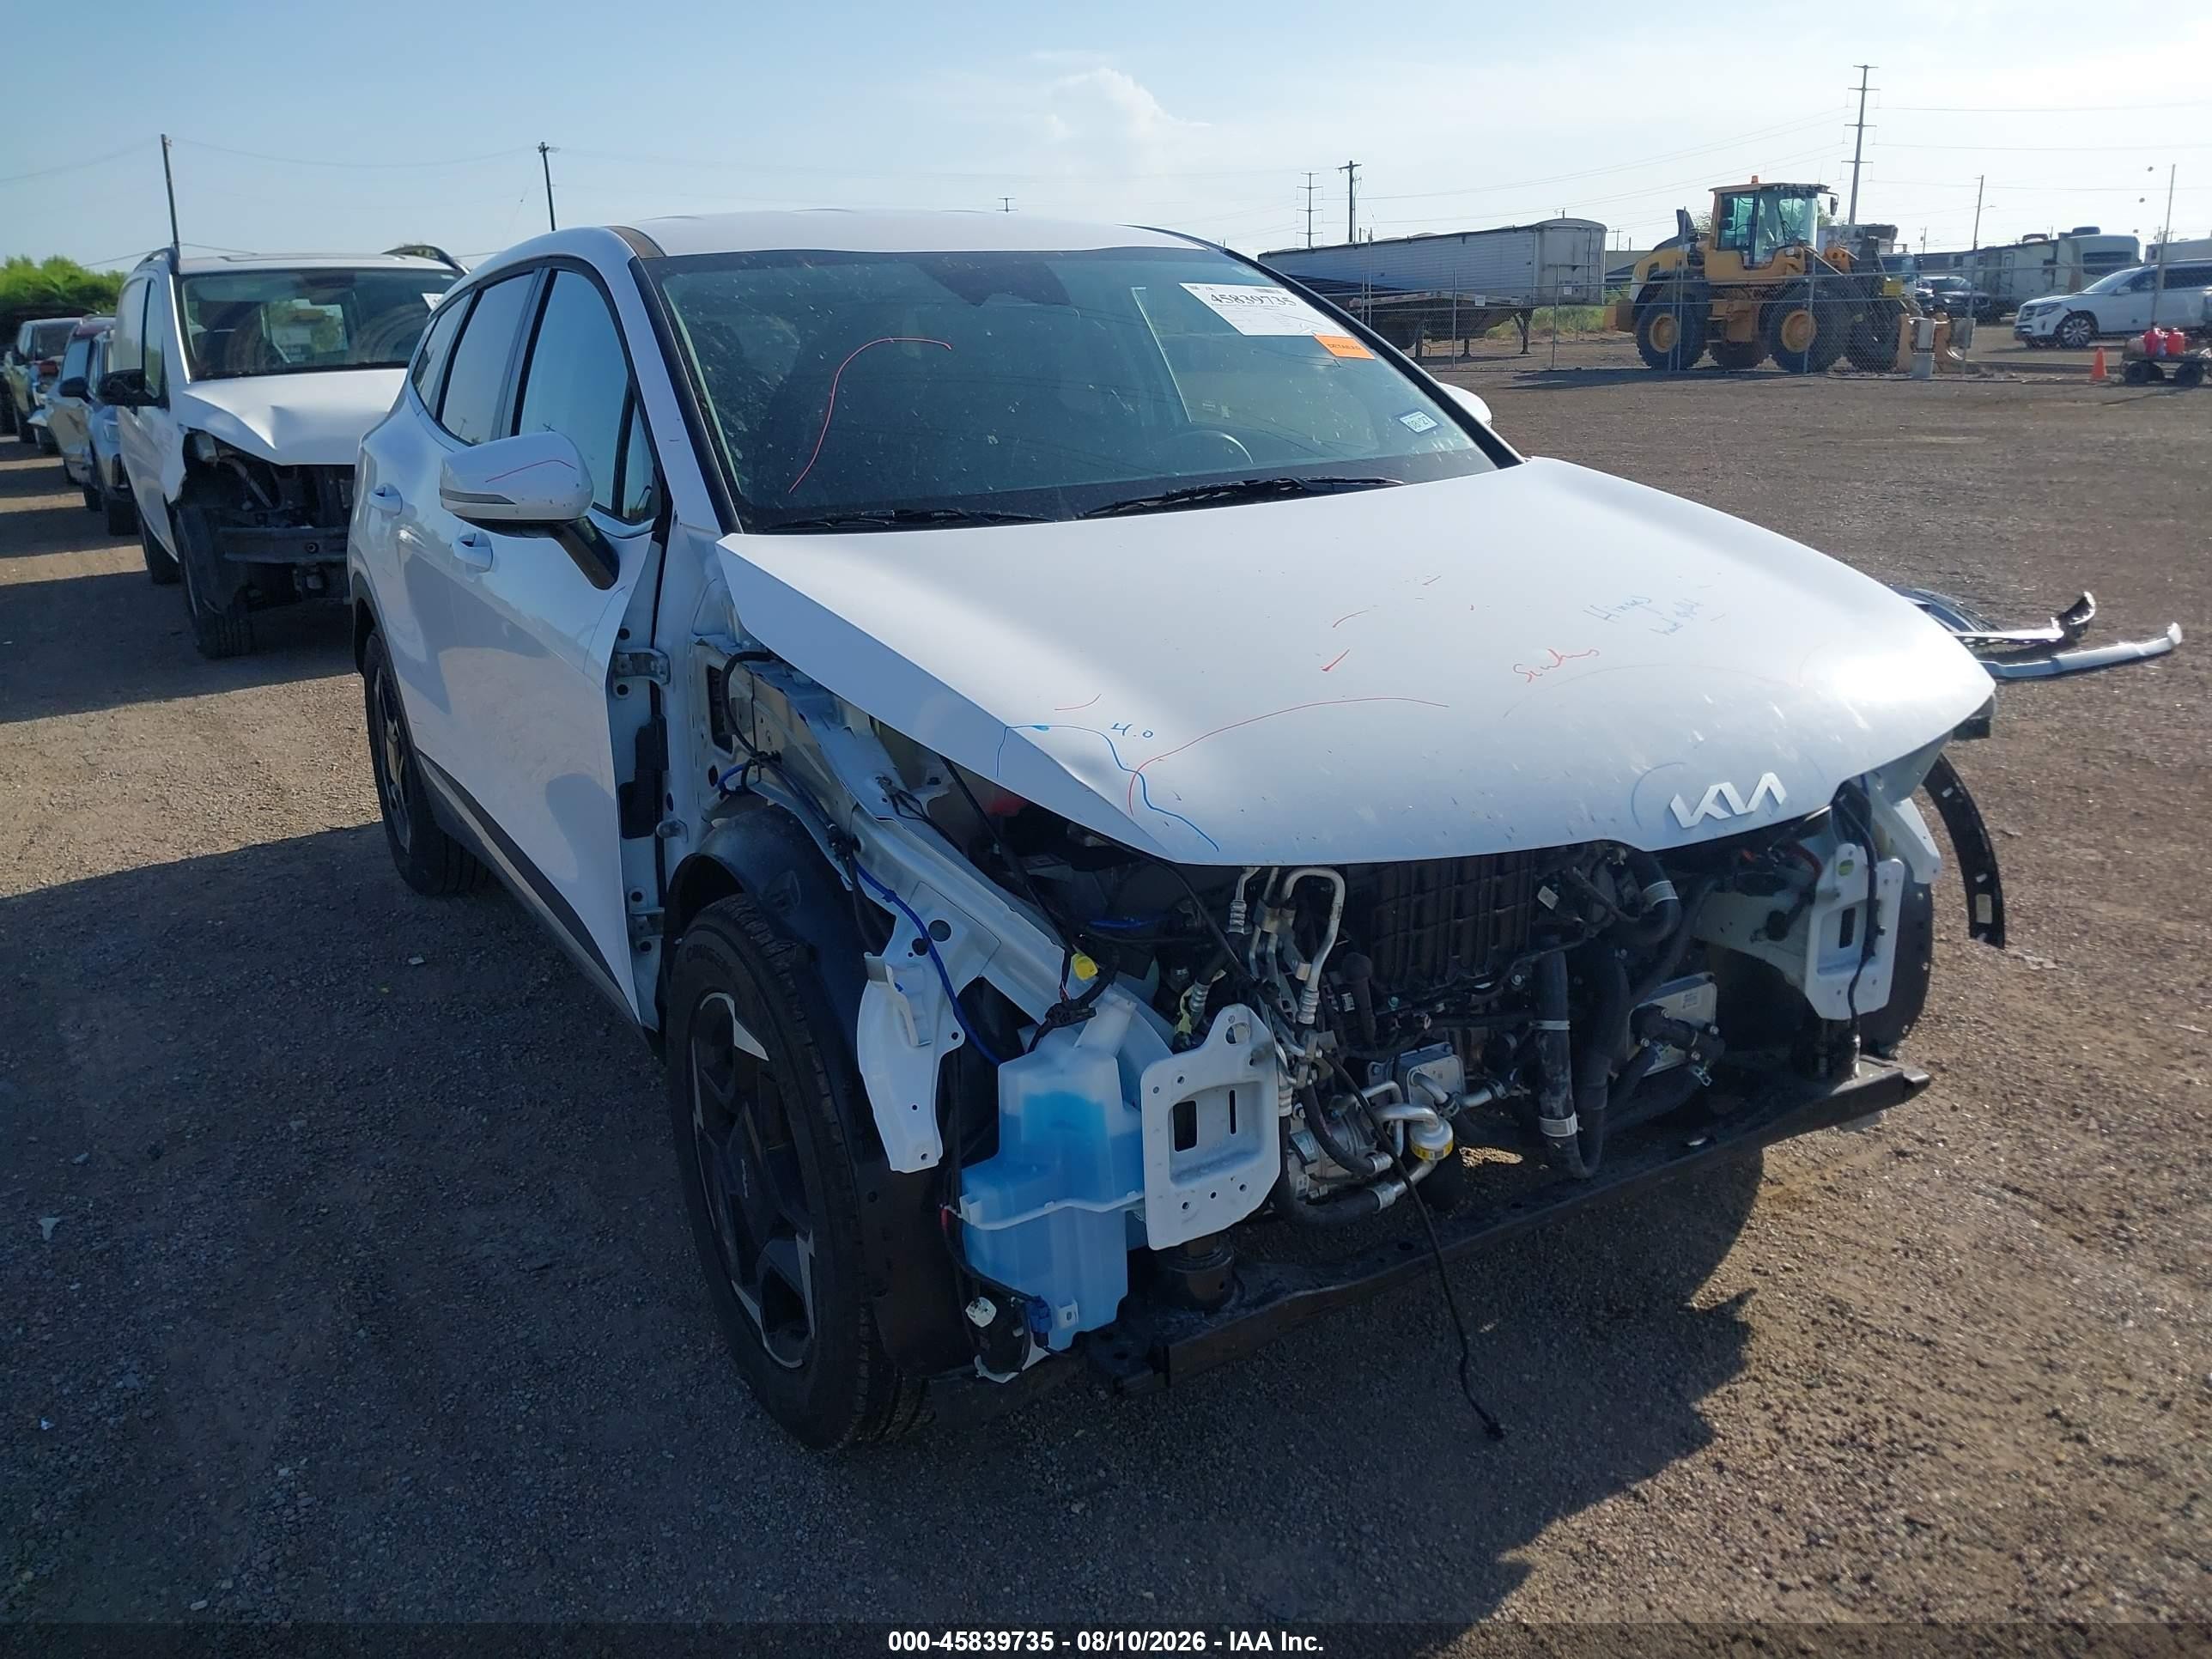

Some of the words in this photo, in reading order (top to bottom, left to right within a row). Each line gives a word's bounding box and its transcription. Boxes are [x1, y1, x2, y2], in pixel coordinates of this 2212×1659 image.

[1210, 294, 1297, 307] 45839735
[1110, 722, 1154, 738] 4.0
[1669, 771, 1787, 830] KIA
